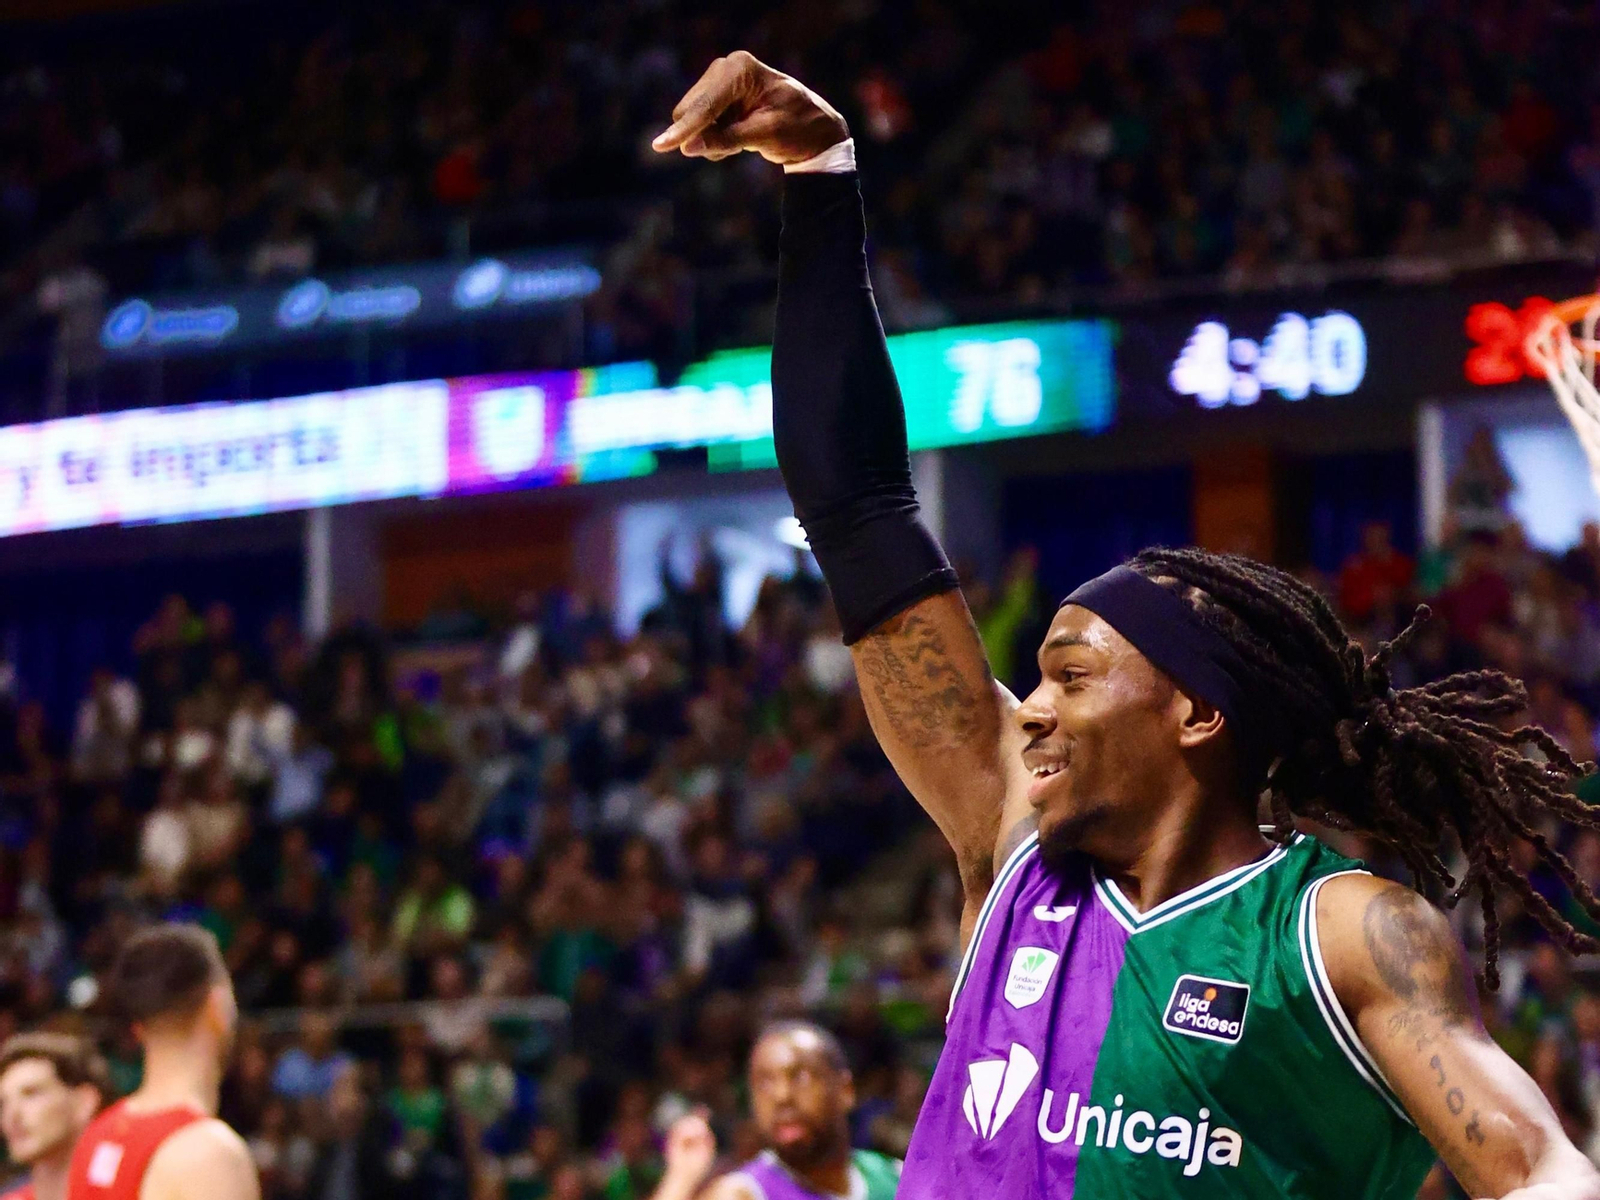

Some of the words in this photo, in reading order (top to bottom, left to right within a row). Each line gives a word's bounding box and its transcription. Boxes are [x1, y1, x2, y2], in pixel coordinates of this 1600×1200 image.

[1169, 311, 1367, 408] 4:40
[1174, 1010, 1240, 1035] endesa
[1179, 992, 1211, 1013] liga
[1037, 1088, 1243, 1176] Unicaja
